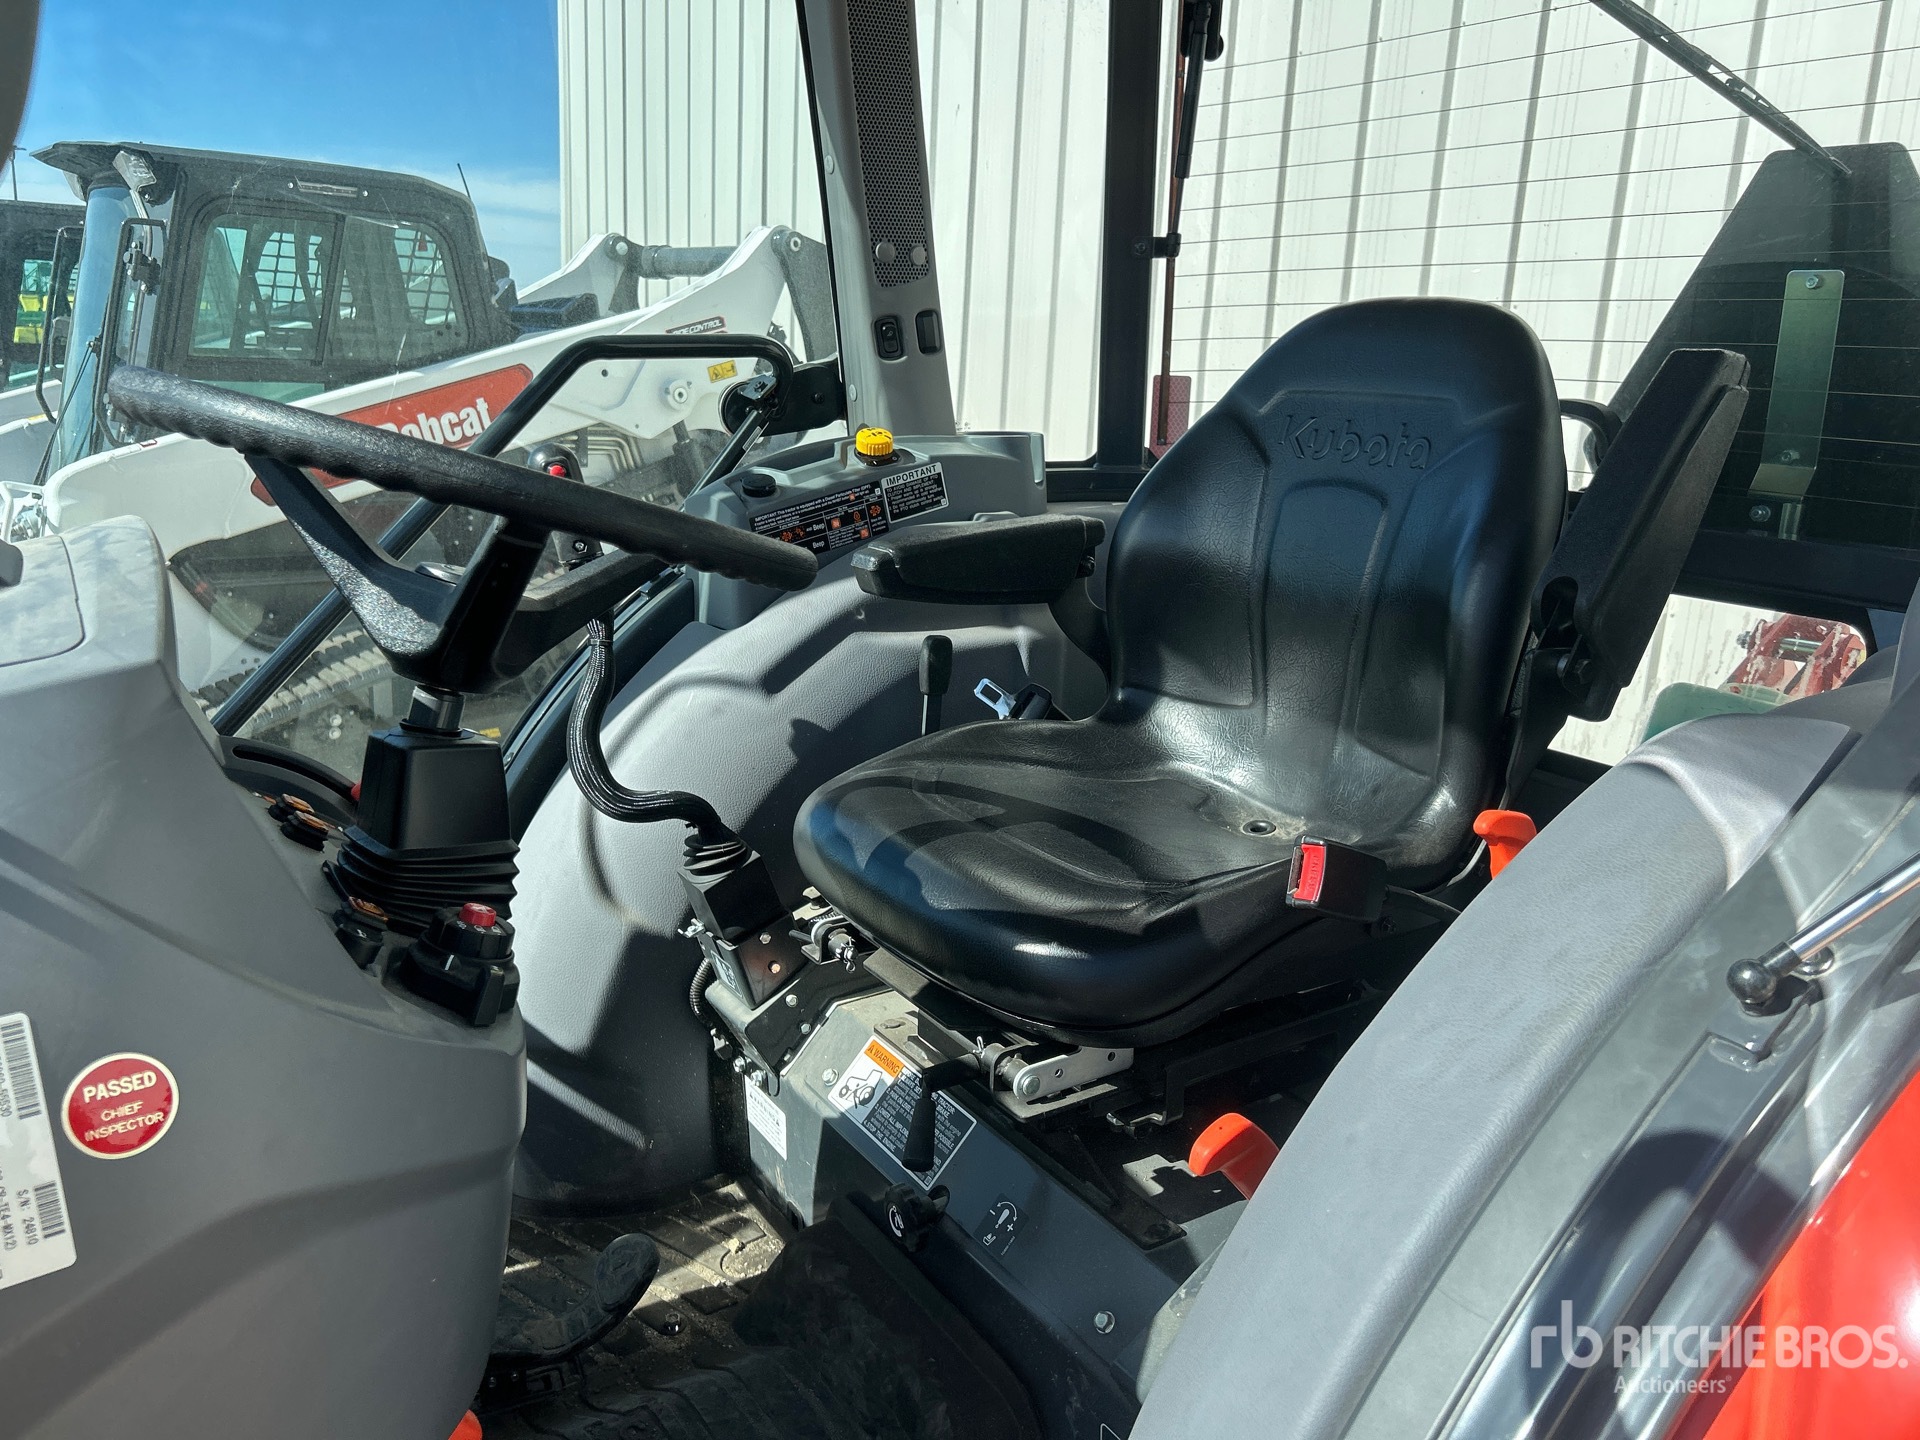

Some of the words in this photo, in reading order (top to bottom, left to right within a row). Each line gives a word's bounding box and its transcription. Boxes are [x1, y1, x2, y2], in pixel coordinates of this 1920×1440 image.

[689, 320, 722, 334] CONTROL
[375, 397, 492, 445] bcat
[1278, 414, 1432, 469] Kubota
[886, 464, 937, 487] IMPORTANT
[873, 1049, 900, 1075] WARNING
[82, 1070, 158, 1104] PASSED
[101, 1101, 144, 1121] CHIEF
[84, 1111, 164, 1142] INSPECTOR
